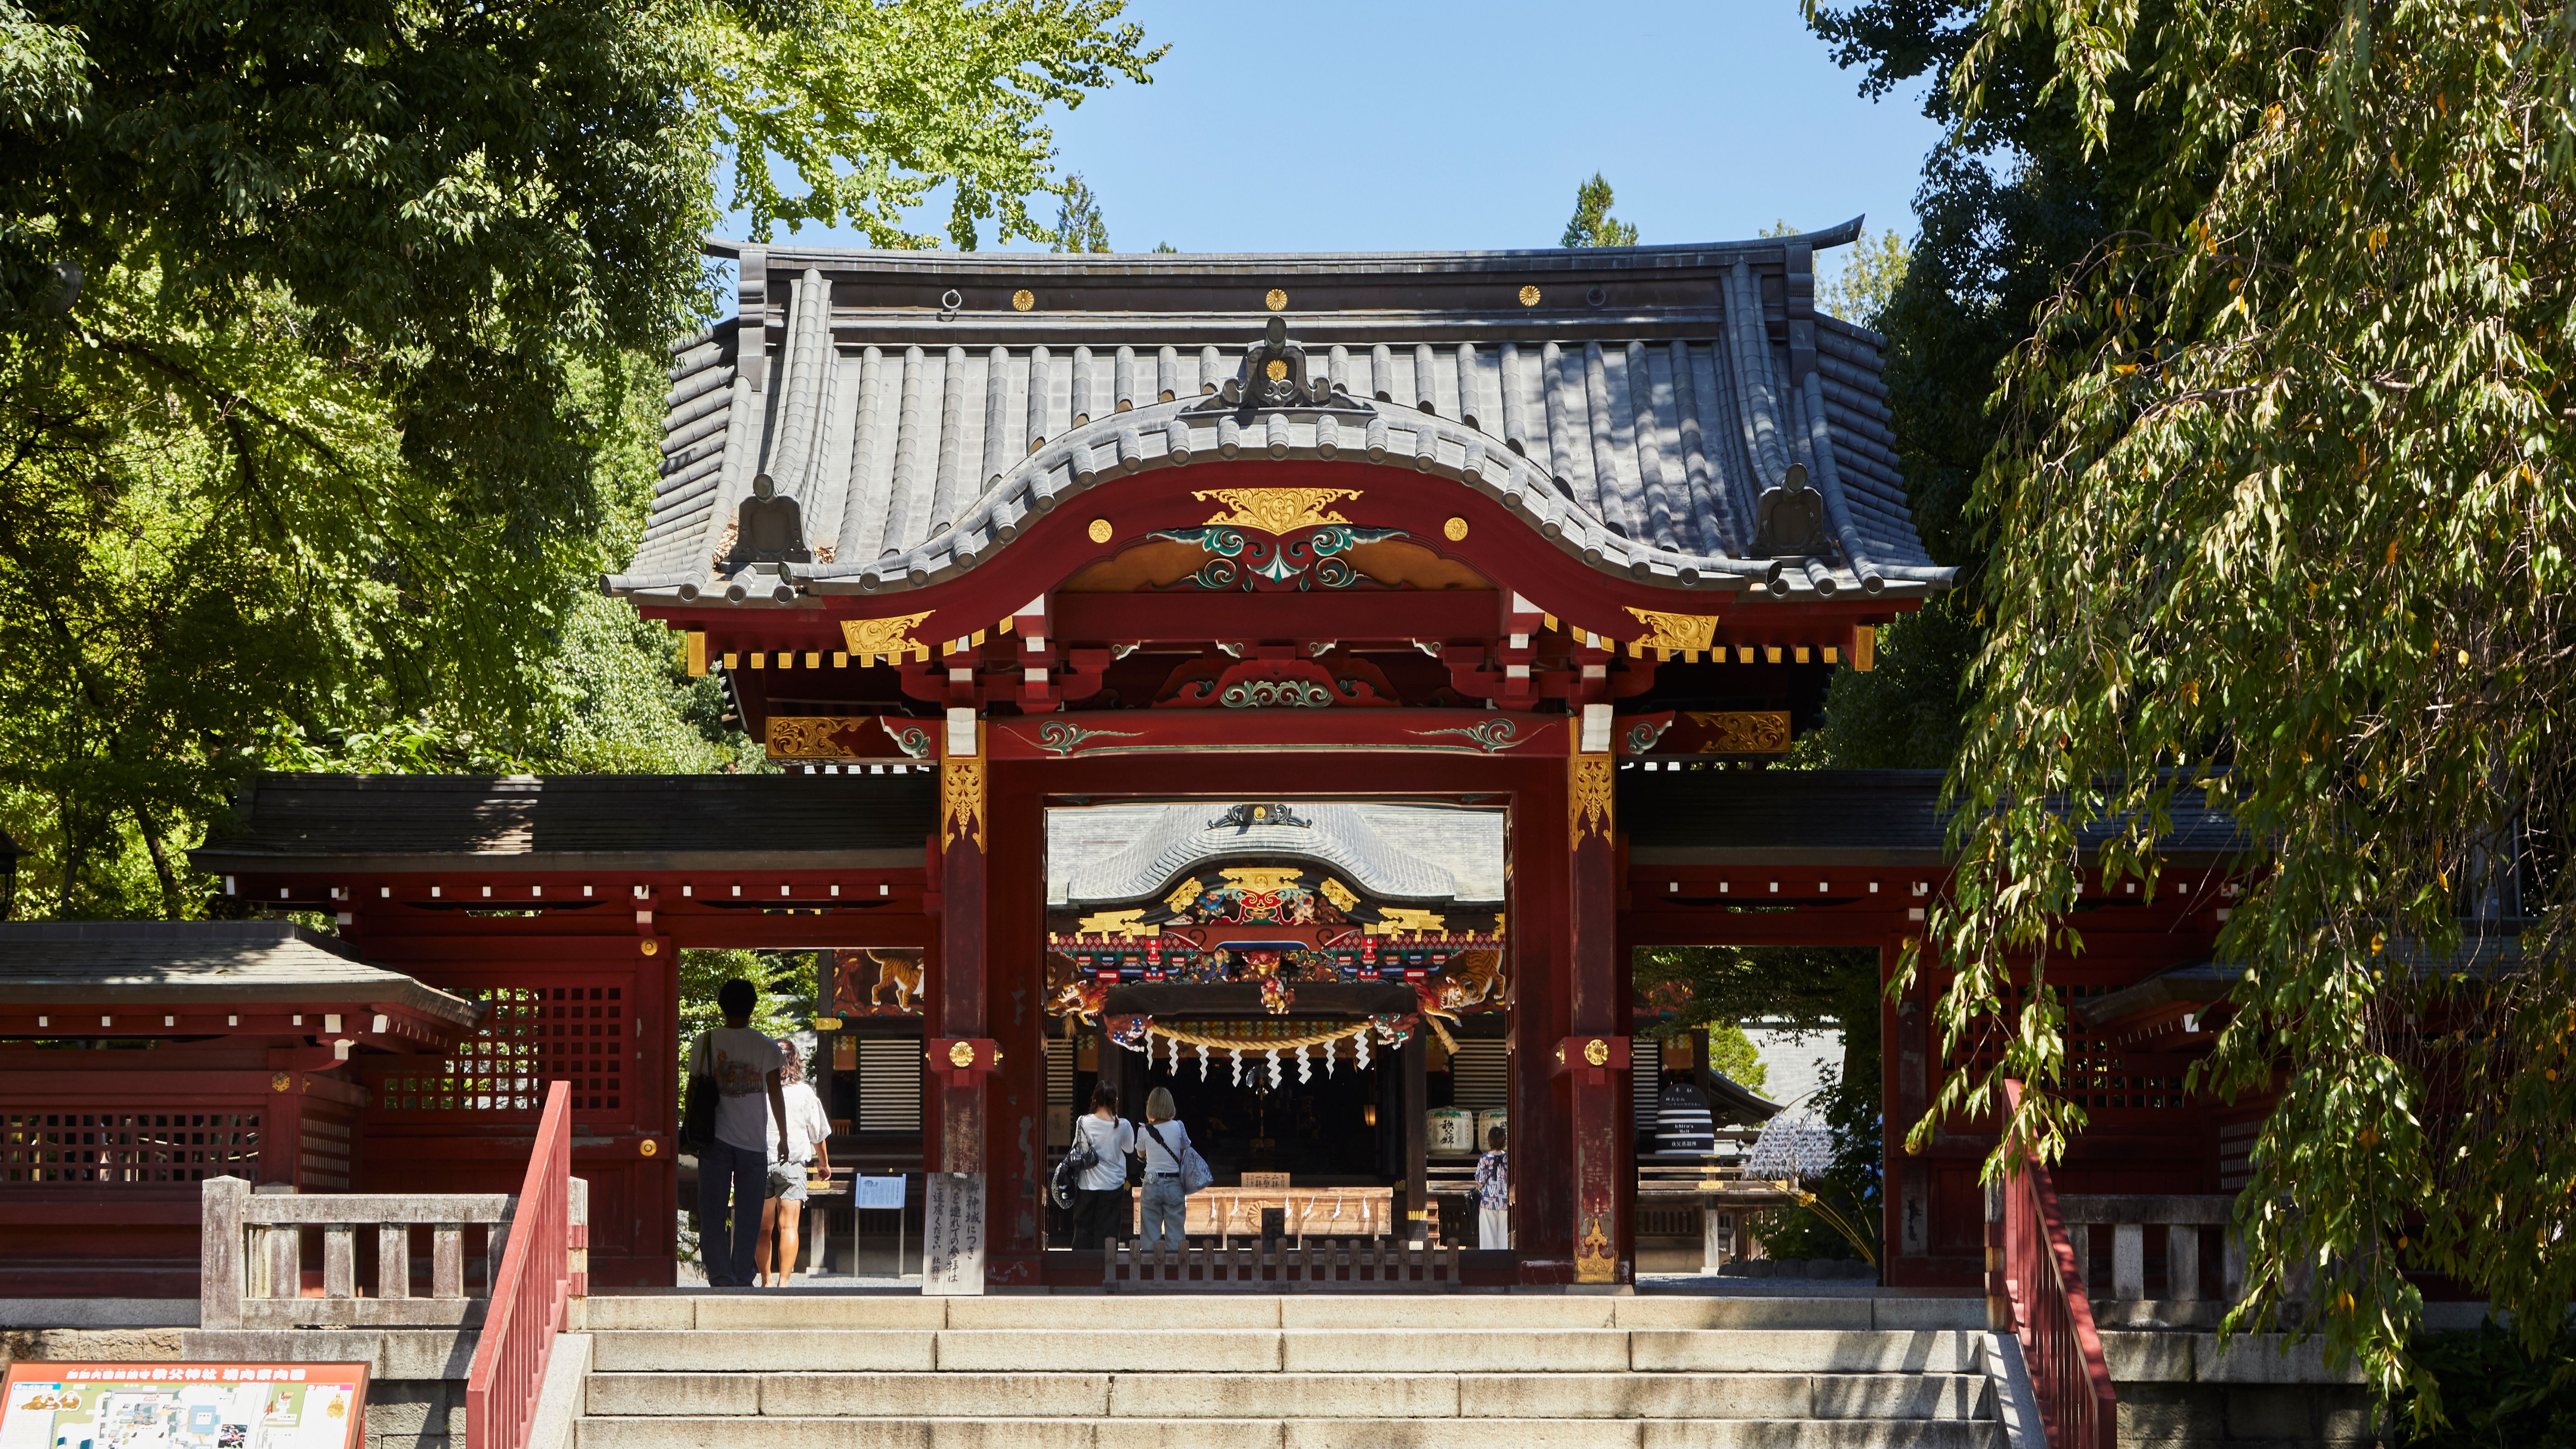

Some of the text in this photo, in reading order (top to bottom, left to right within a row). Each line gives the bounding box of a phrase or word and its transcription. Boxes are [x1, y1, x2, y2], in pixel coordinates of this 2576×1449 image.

[1439, 1119, 1454, 1149] 秩父錦
[931, 1182, 946, 1284] ご遠慮ください 社務所
[946, 1181, 962, 1283] 犬を連れての参拝は
[966, 1181, 981, 1259] 御神域につき
